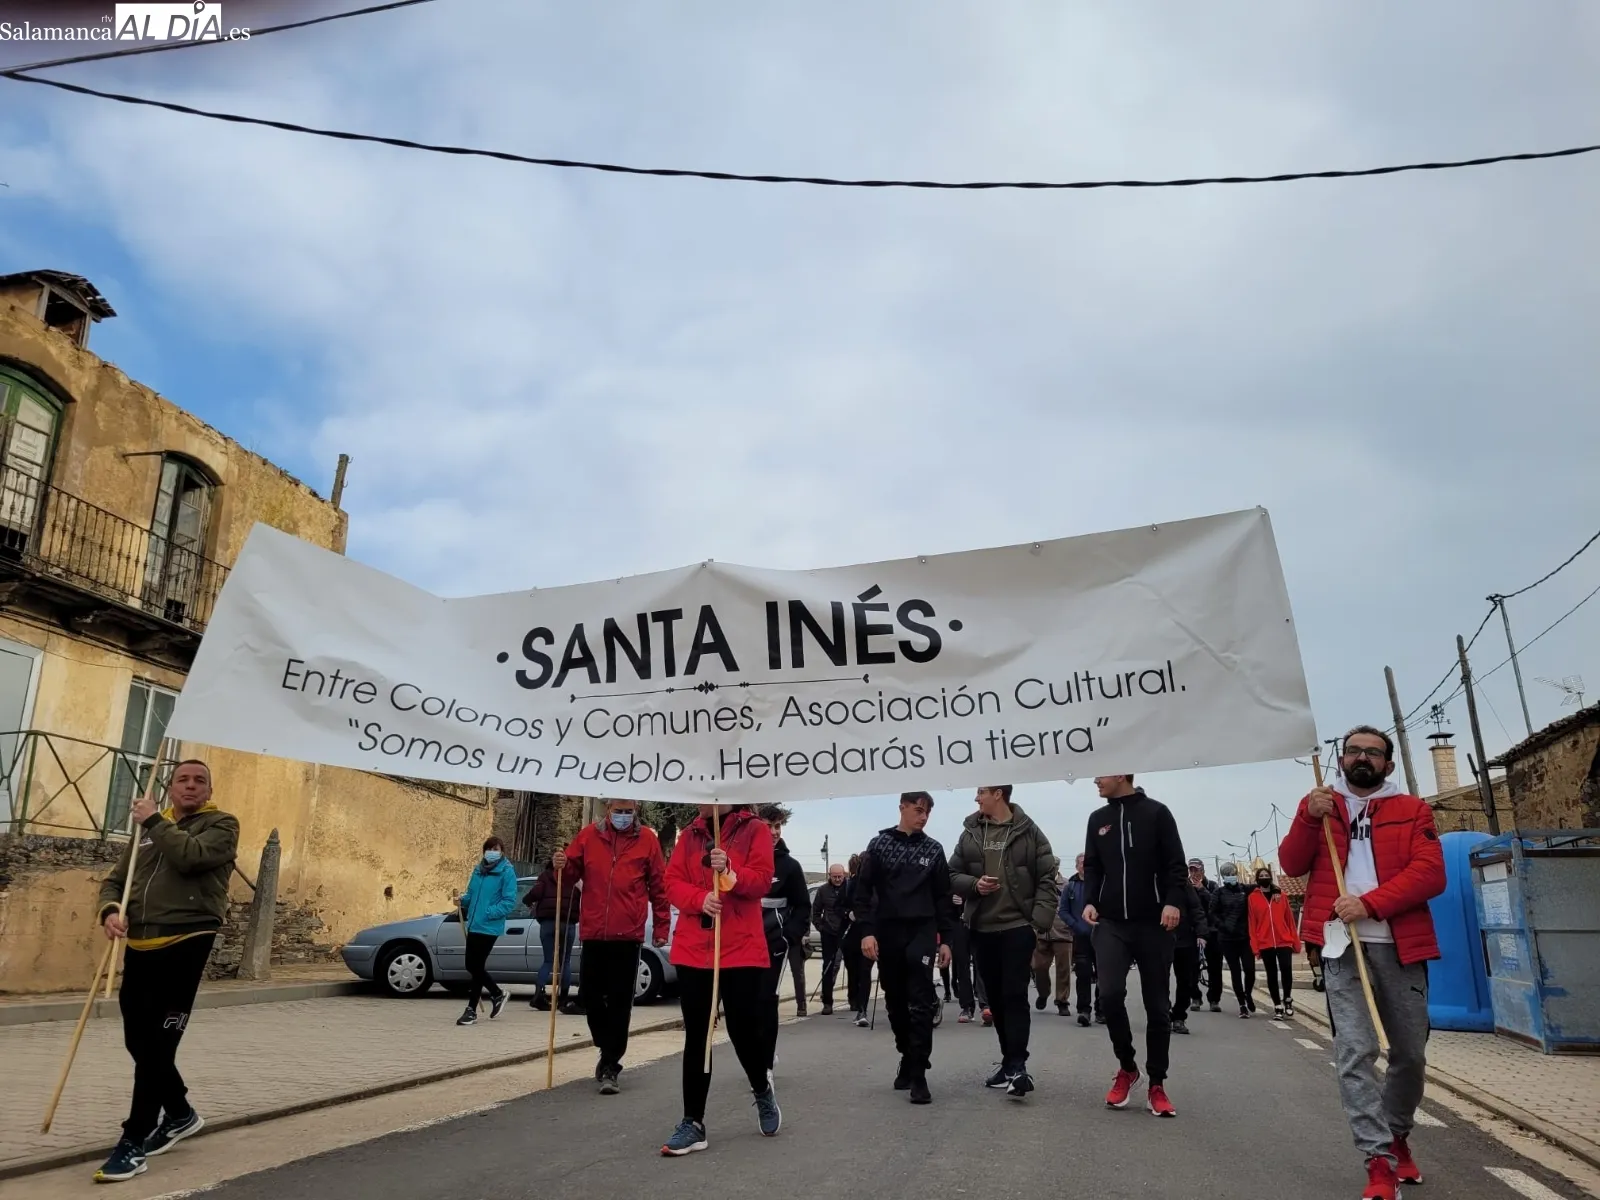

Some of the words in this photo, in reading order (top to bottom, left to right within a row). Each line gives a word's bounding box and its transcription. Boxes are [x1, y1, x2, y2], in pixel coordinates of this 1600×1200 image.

[281, 657, 378, 705] Entre
[389, 682, 544, 740] Colonos
[555, 717, 574, 747] y
[583, 705, 763, 739] Comunes,
[777, 684, 1001, 728] Asociación
[1014, 659, 1187, 710] Cultural.
[496, 752, 543, 776] un
[937, 734, 974, 766] la
